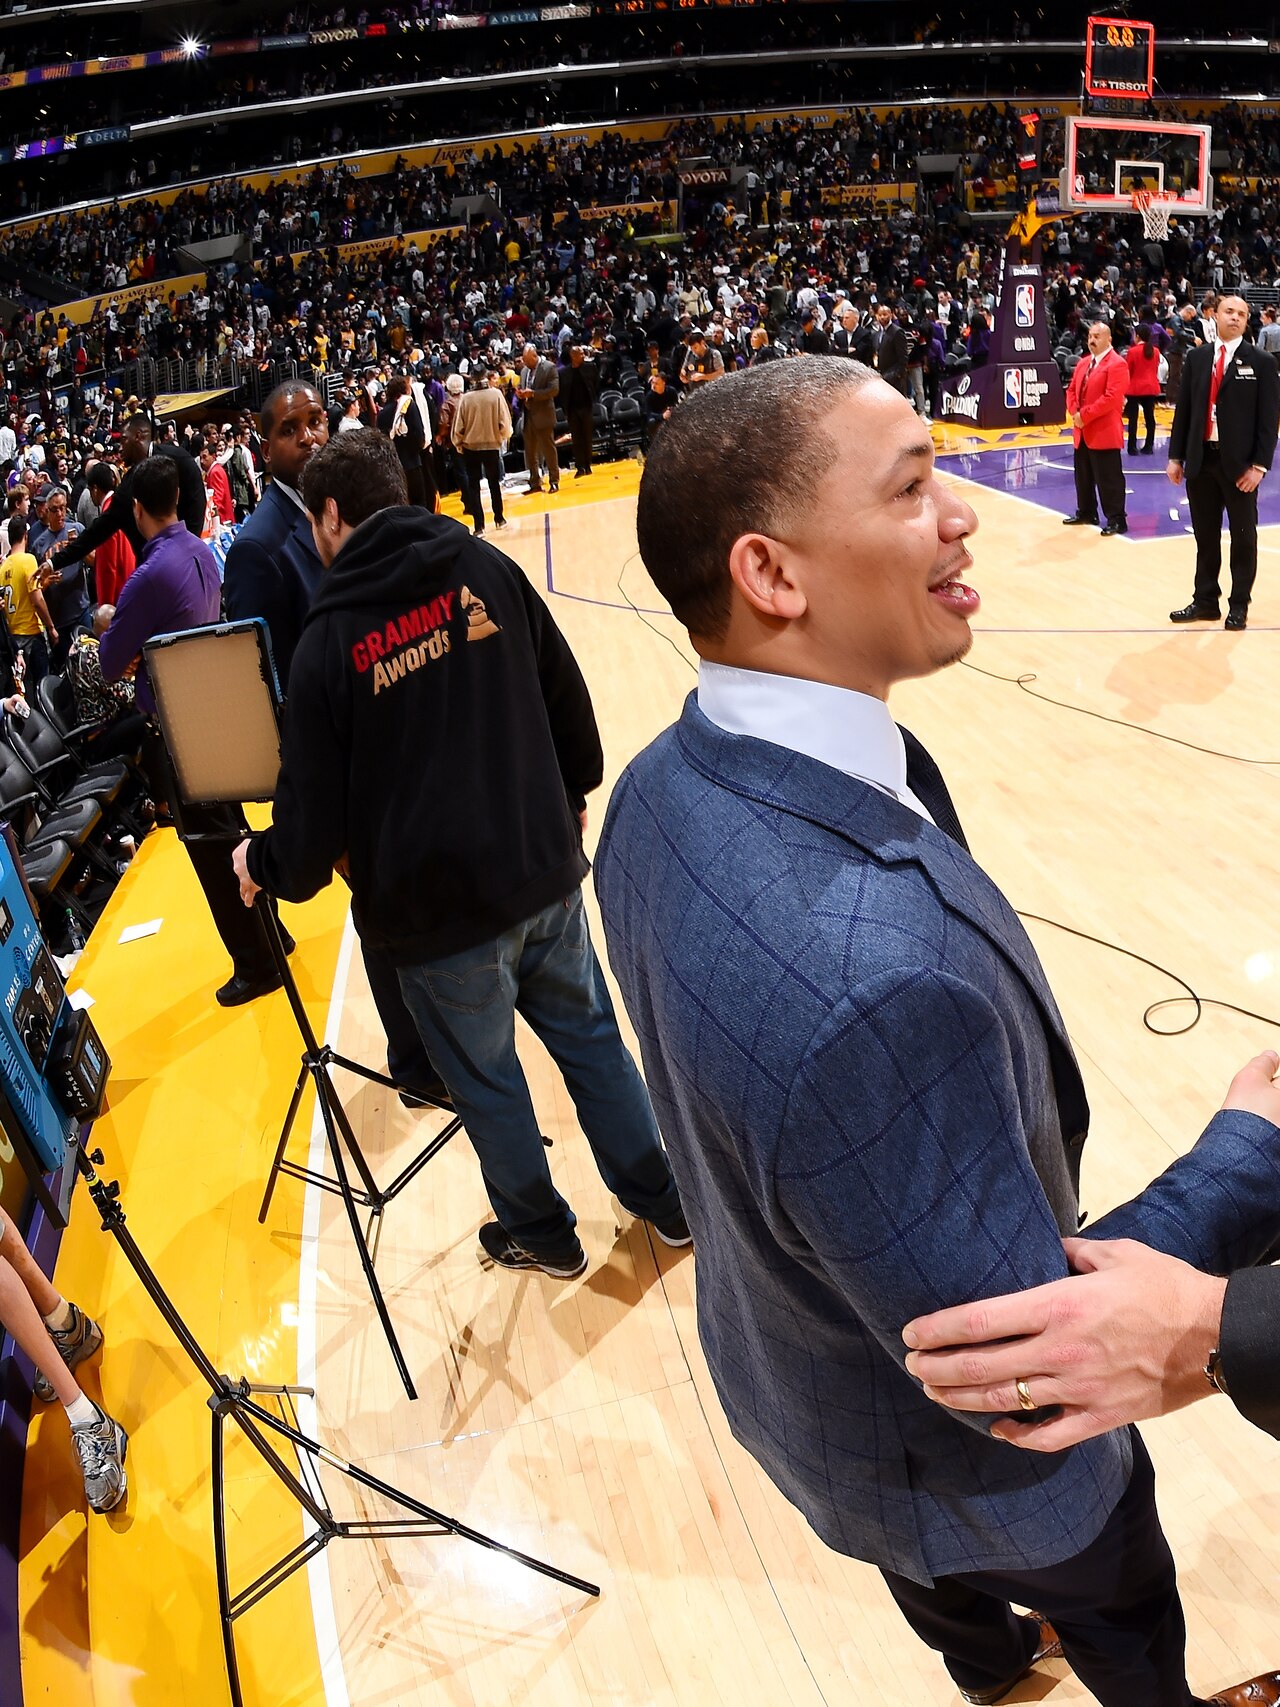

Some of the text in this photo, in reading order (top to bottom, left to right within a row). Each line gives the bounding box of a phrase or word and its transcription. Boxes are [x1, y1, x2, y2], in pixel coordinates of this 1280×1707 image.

[502, 13, 538, 23] DELTA
[311, 27, 359, 44] TOYOTA
[1108, 80, 1148, 92] TISSOT
[95, 130, 128, 144] DELTA
[1014, 337, 1036, 352] @NBA
[1023, 368, 1038, 382] NBA
[941, 391, 980, 420] SPALDING
[351, 591, 456, 673] GRAMMY
[373, 629, 451, 696] Awards
[65, 1070, 88, 1108] STAPLES
